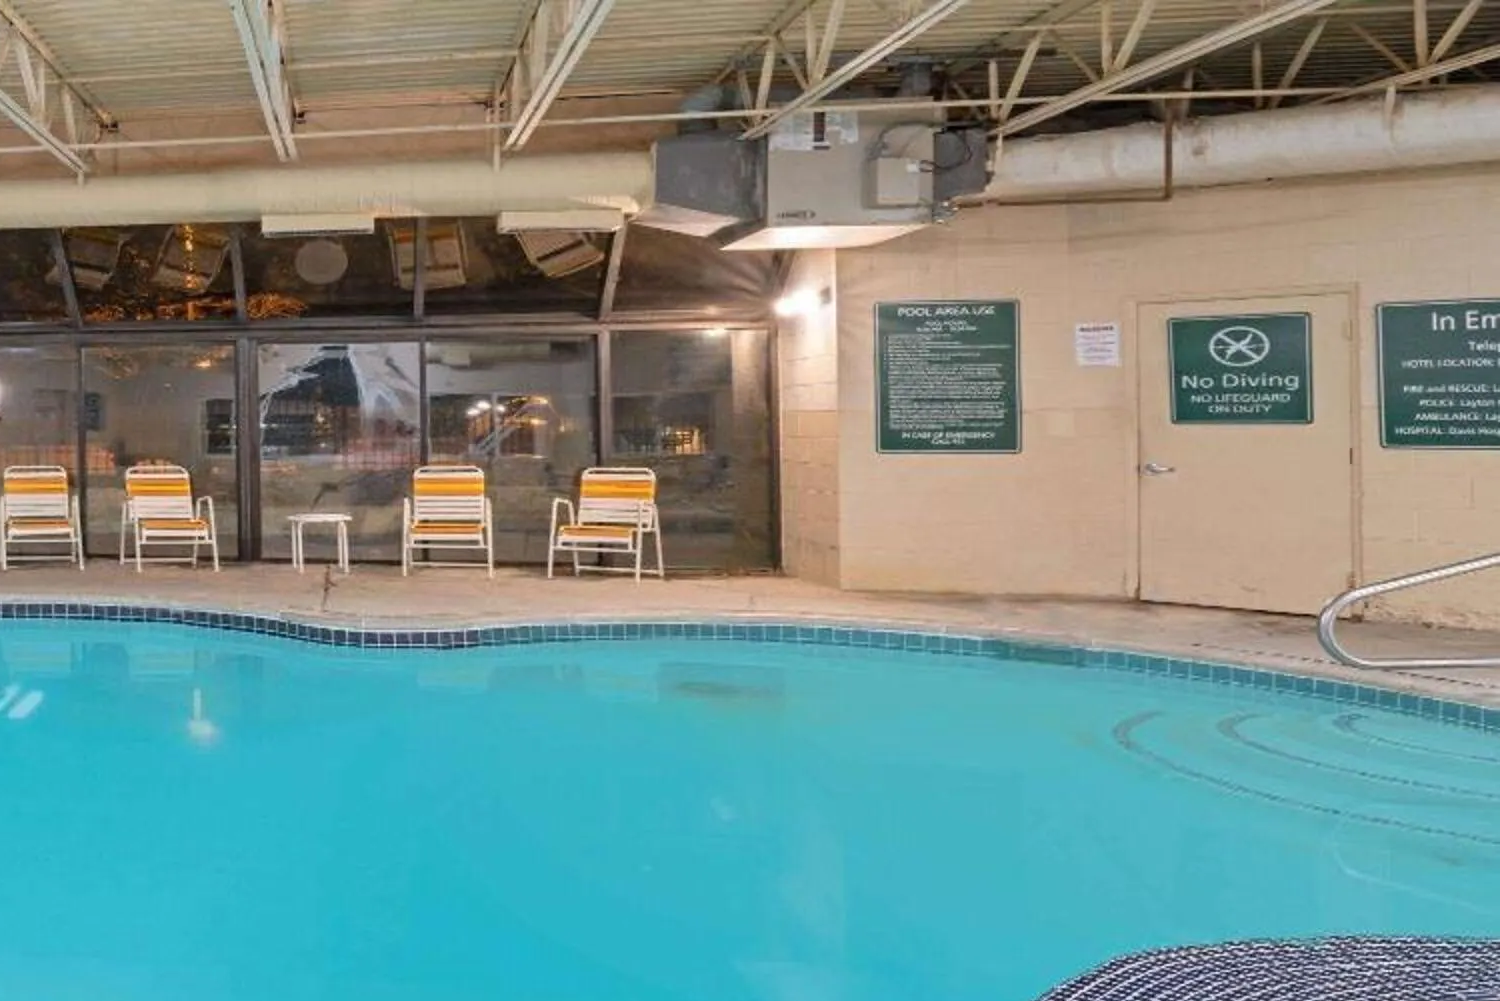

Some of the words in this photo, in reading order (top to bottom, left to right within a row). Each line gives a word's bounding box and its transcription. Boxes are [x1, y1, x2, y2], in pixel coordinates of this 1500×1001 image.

[897, 306, 932, 317] POOL
[935, 305, 969, 316] AREA
[972, 305, 996, 316] USE
[1431, 311, 1455, 331] In
[1401, 359, 1433, 368] HOTEL
[1181, 375, 1214, 389] No
[1222, 372, 1299, 391] Diving
[1190, 393, 1213, 403] NO
[1215, 393, 1291, 403] LIFEGUARD
[1208, 404, 1231, 413] ON
[1233, 403, 1272, 413] DUTY
